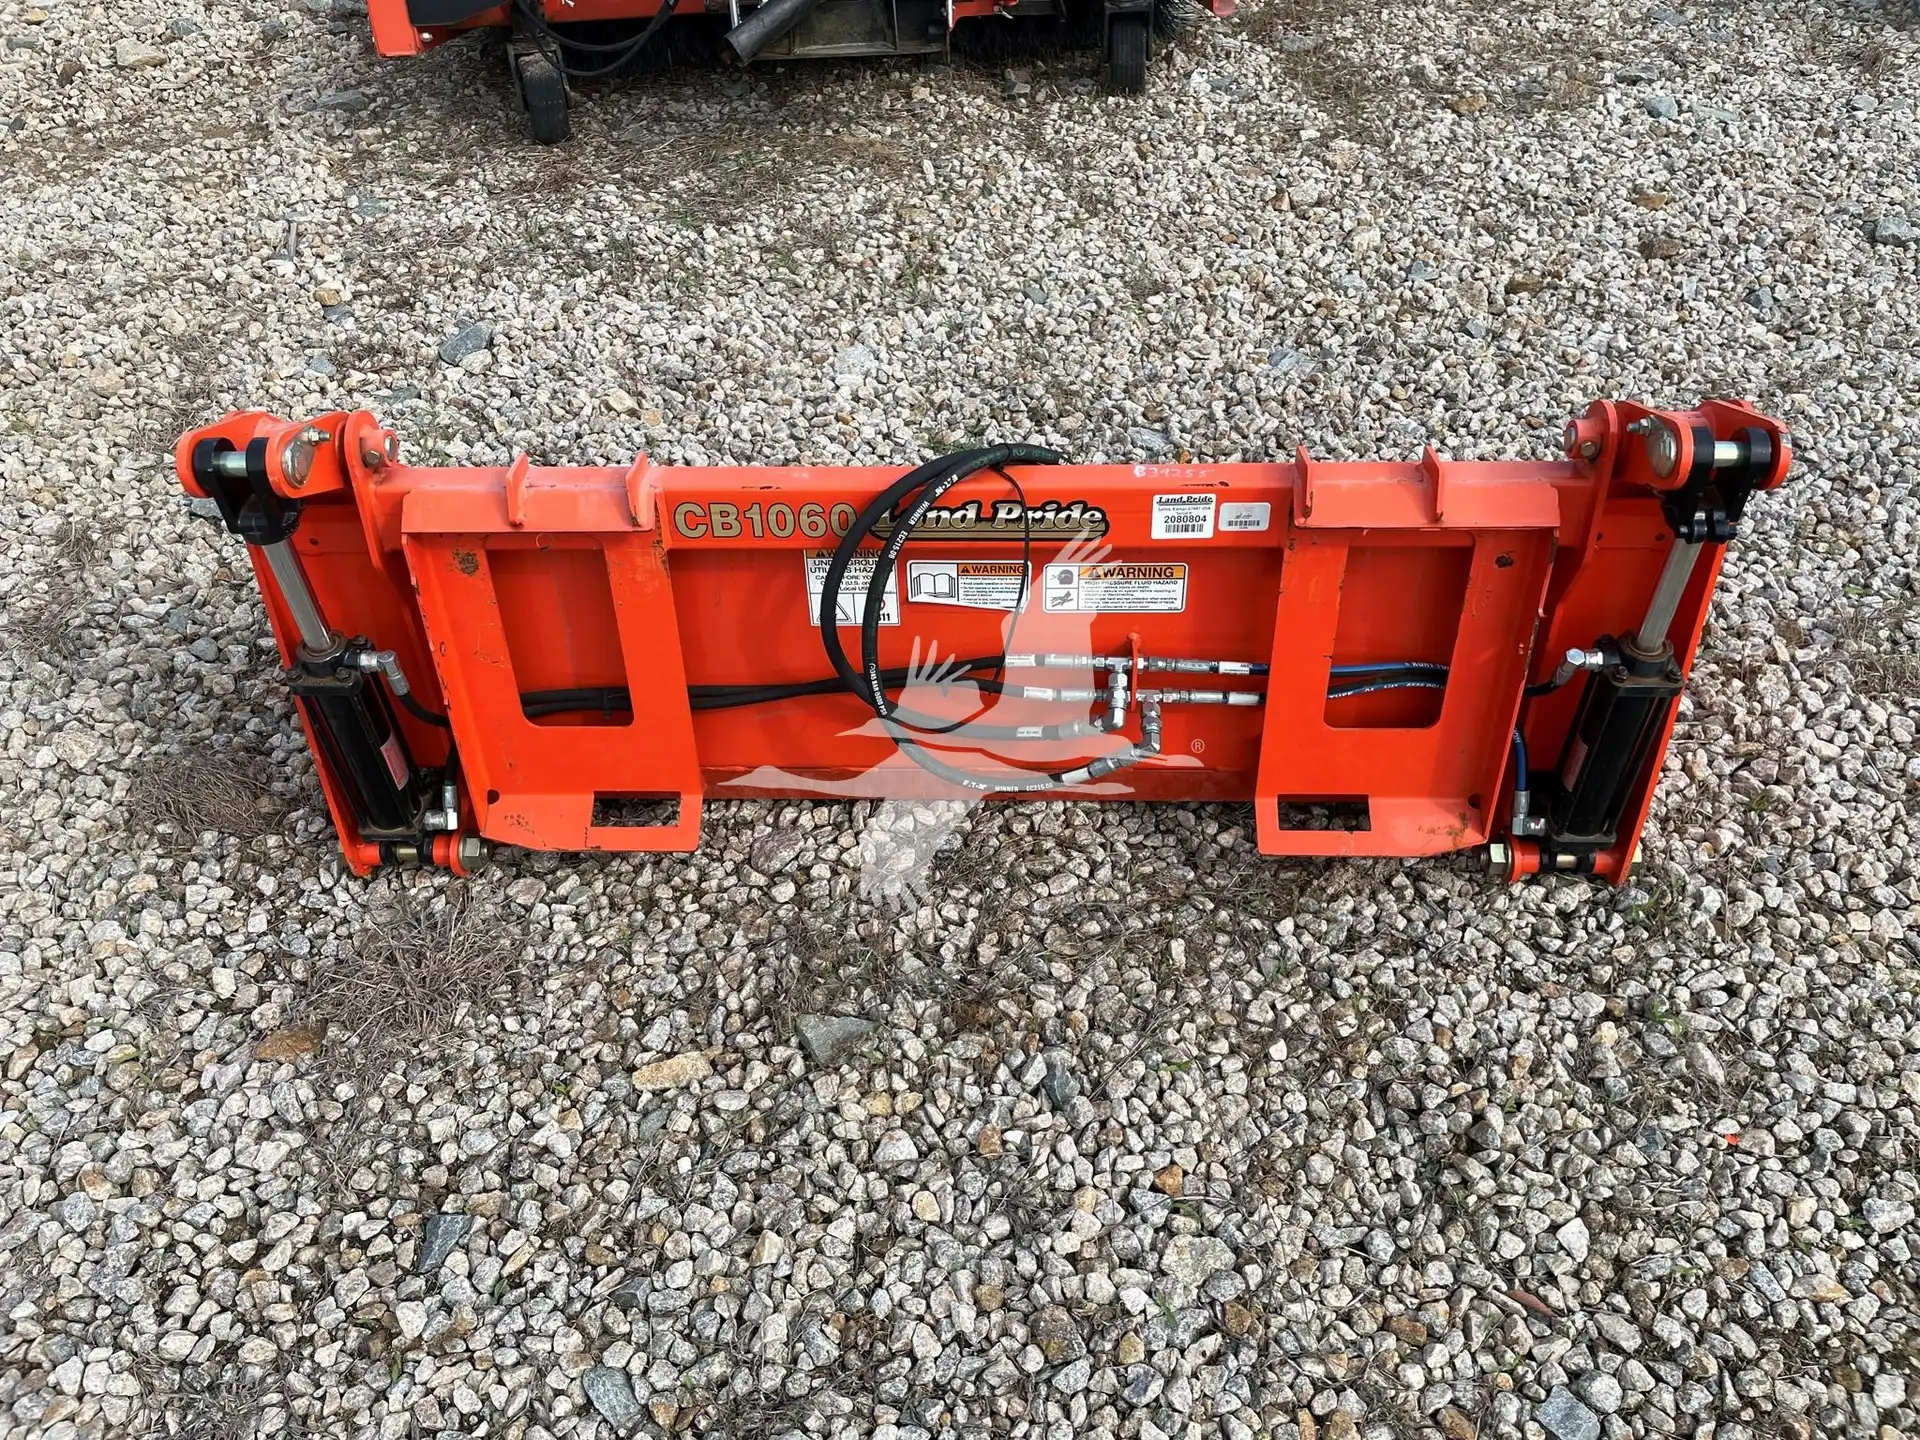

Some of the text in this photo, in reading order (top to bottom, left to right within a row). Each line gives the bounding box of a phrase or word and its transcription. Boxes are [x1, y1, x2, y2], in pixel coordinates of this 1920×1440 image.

[1157, 495, 1214, 504] Land Pride
[872, 501, 1103, 531] Lnd Pride
[908, 500, 931, 526] WINNER
[673, 501, 858, 538] CB1060
[1163, 514, 1207, 524] 2080804
[829, 549, 882, 558] WNING
[971, 564, 1025, 575] WARNING
[1102, 566, 1174, 578] WARNING
[994, 785, 1019, 793] WINNER
